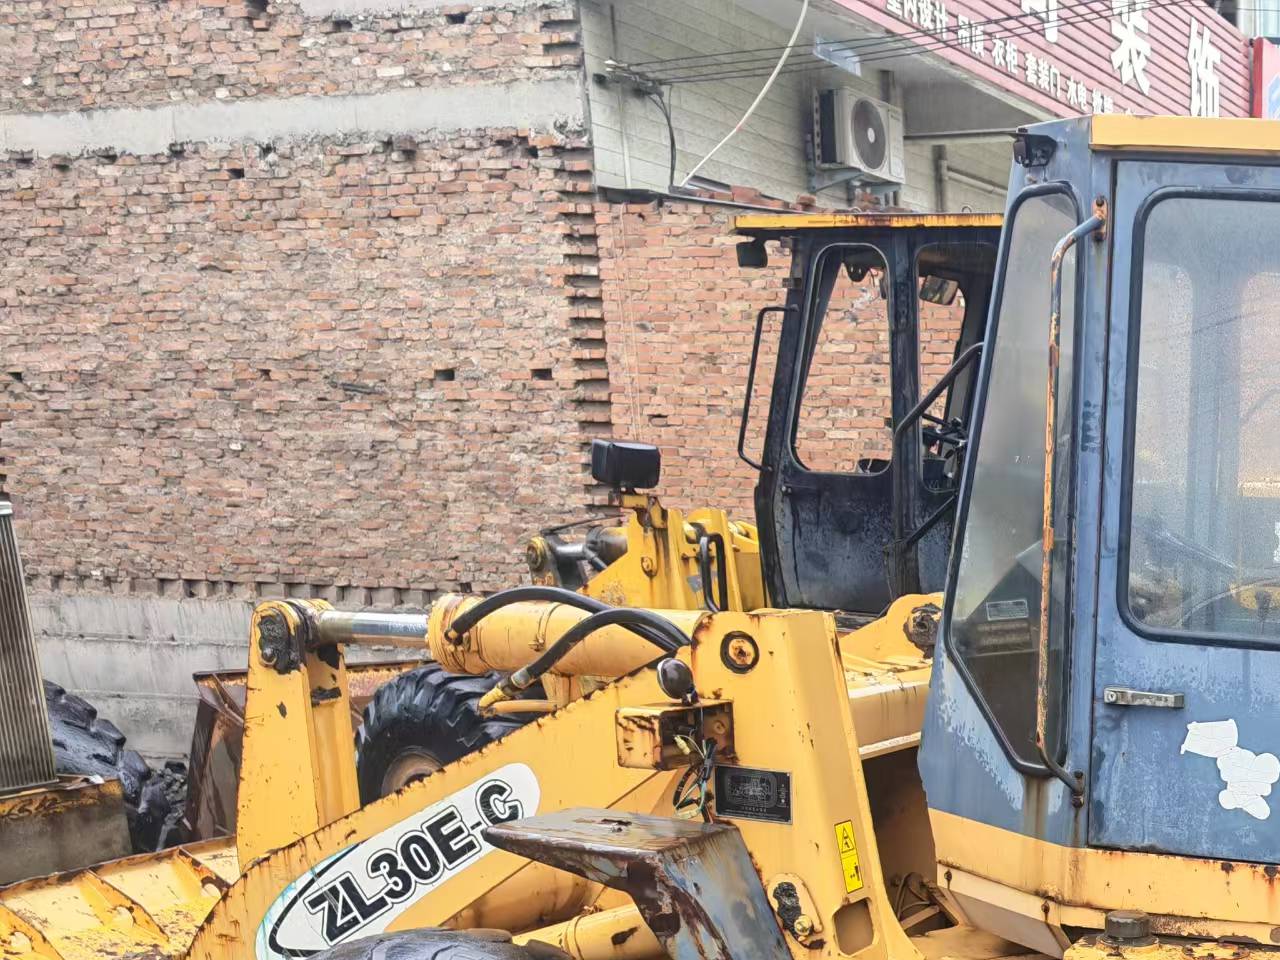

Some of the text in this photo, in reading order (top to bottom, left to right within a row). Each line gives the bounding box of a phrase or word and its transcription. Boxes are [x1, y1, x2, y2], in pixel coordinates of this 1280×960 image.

[991, 35, 1018, 75] 衣柜
[1025, 51, 1061, 98] 套装门
[1066, 75, 1087, 111] 水电
[303, 779, 524, 948] ZL30E-C
